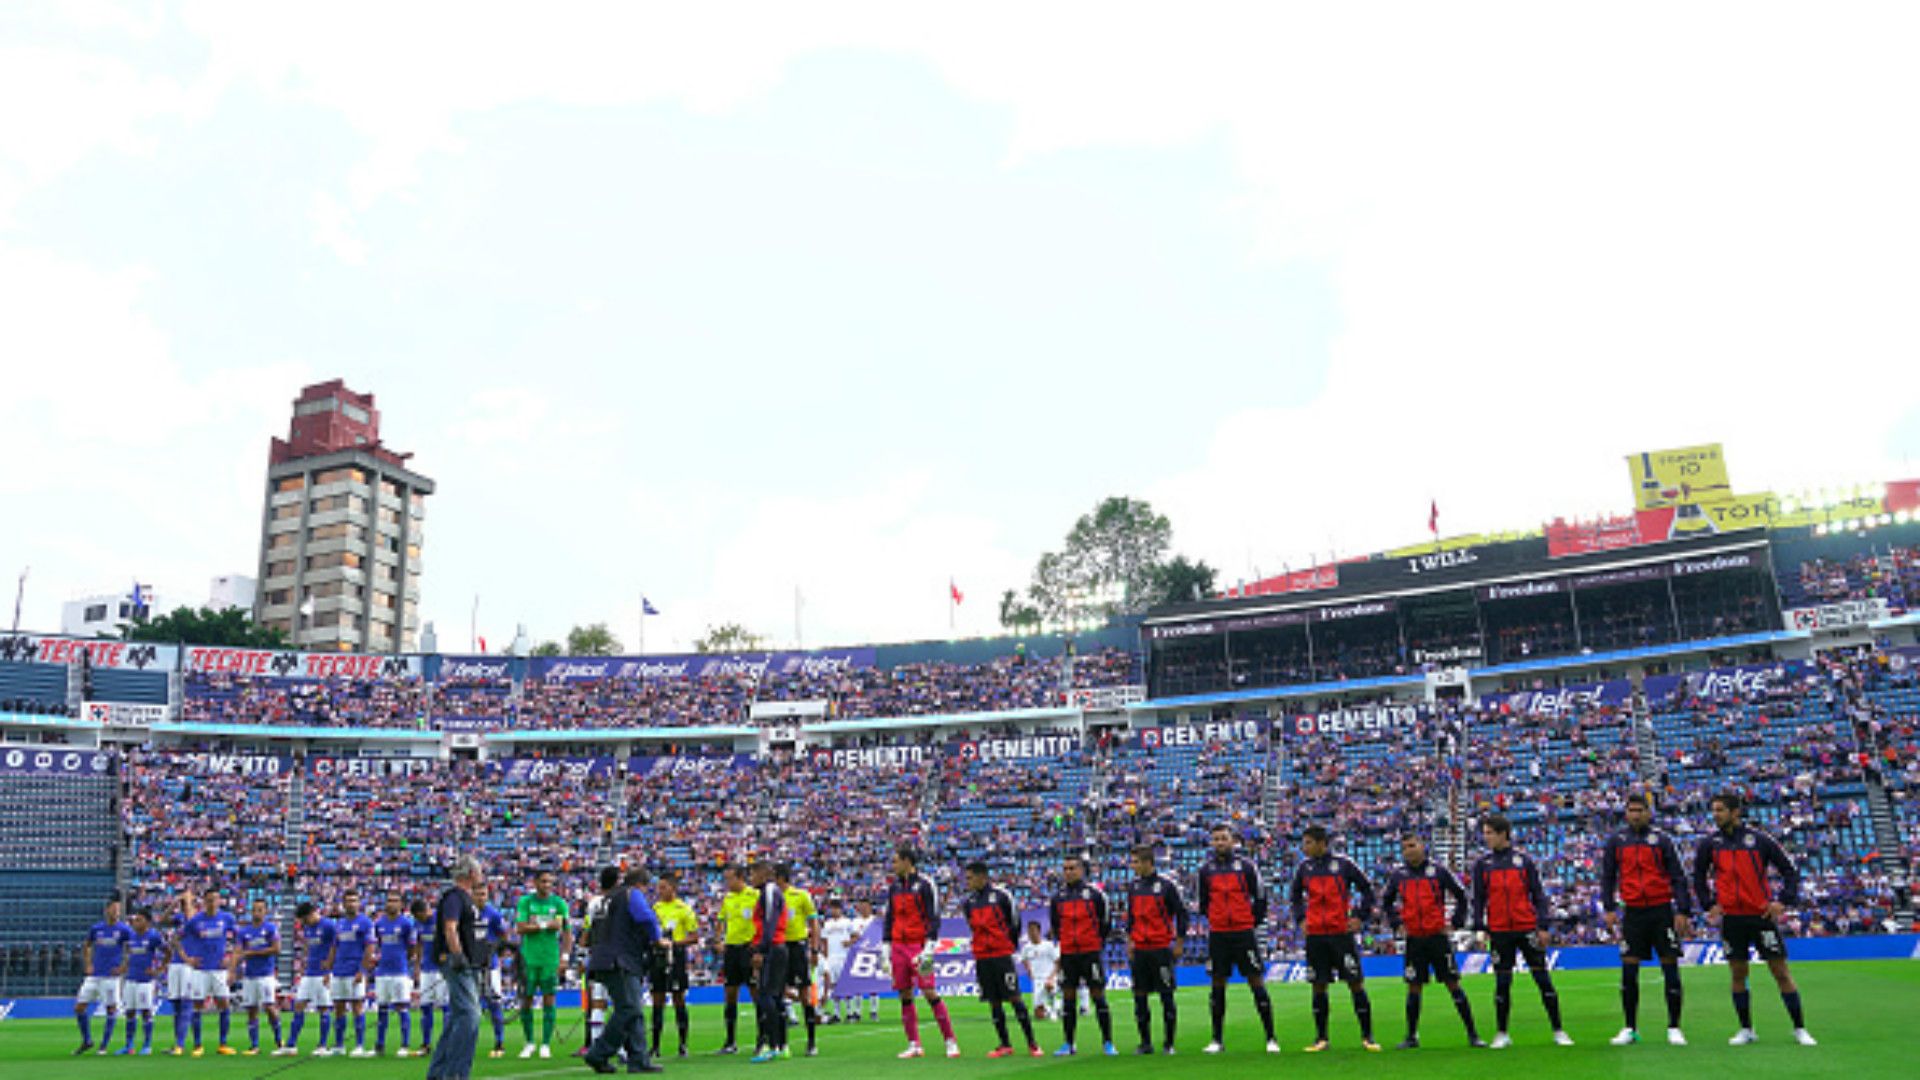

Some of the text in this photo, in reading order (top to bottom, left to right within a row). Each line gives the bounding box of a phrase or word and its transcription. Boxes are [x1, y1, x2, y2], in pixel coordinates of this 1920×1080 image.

[191, 648, 273, 673] TECATE
[305, 655, 385, 678] TECATE
[1318, 705, 1416, 731] CEMENTO
[979, 735, 1070, 759] CEMENTO
